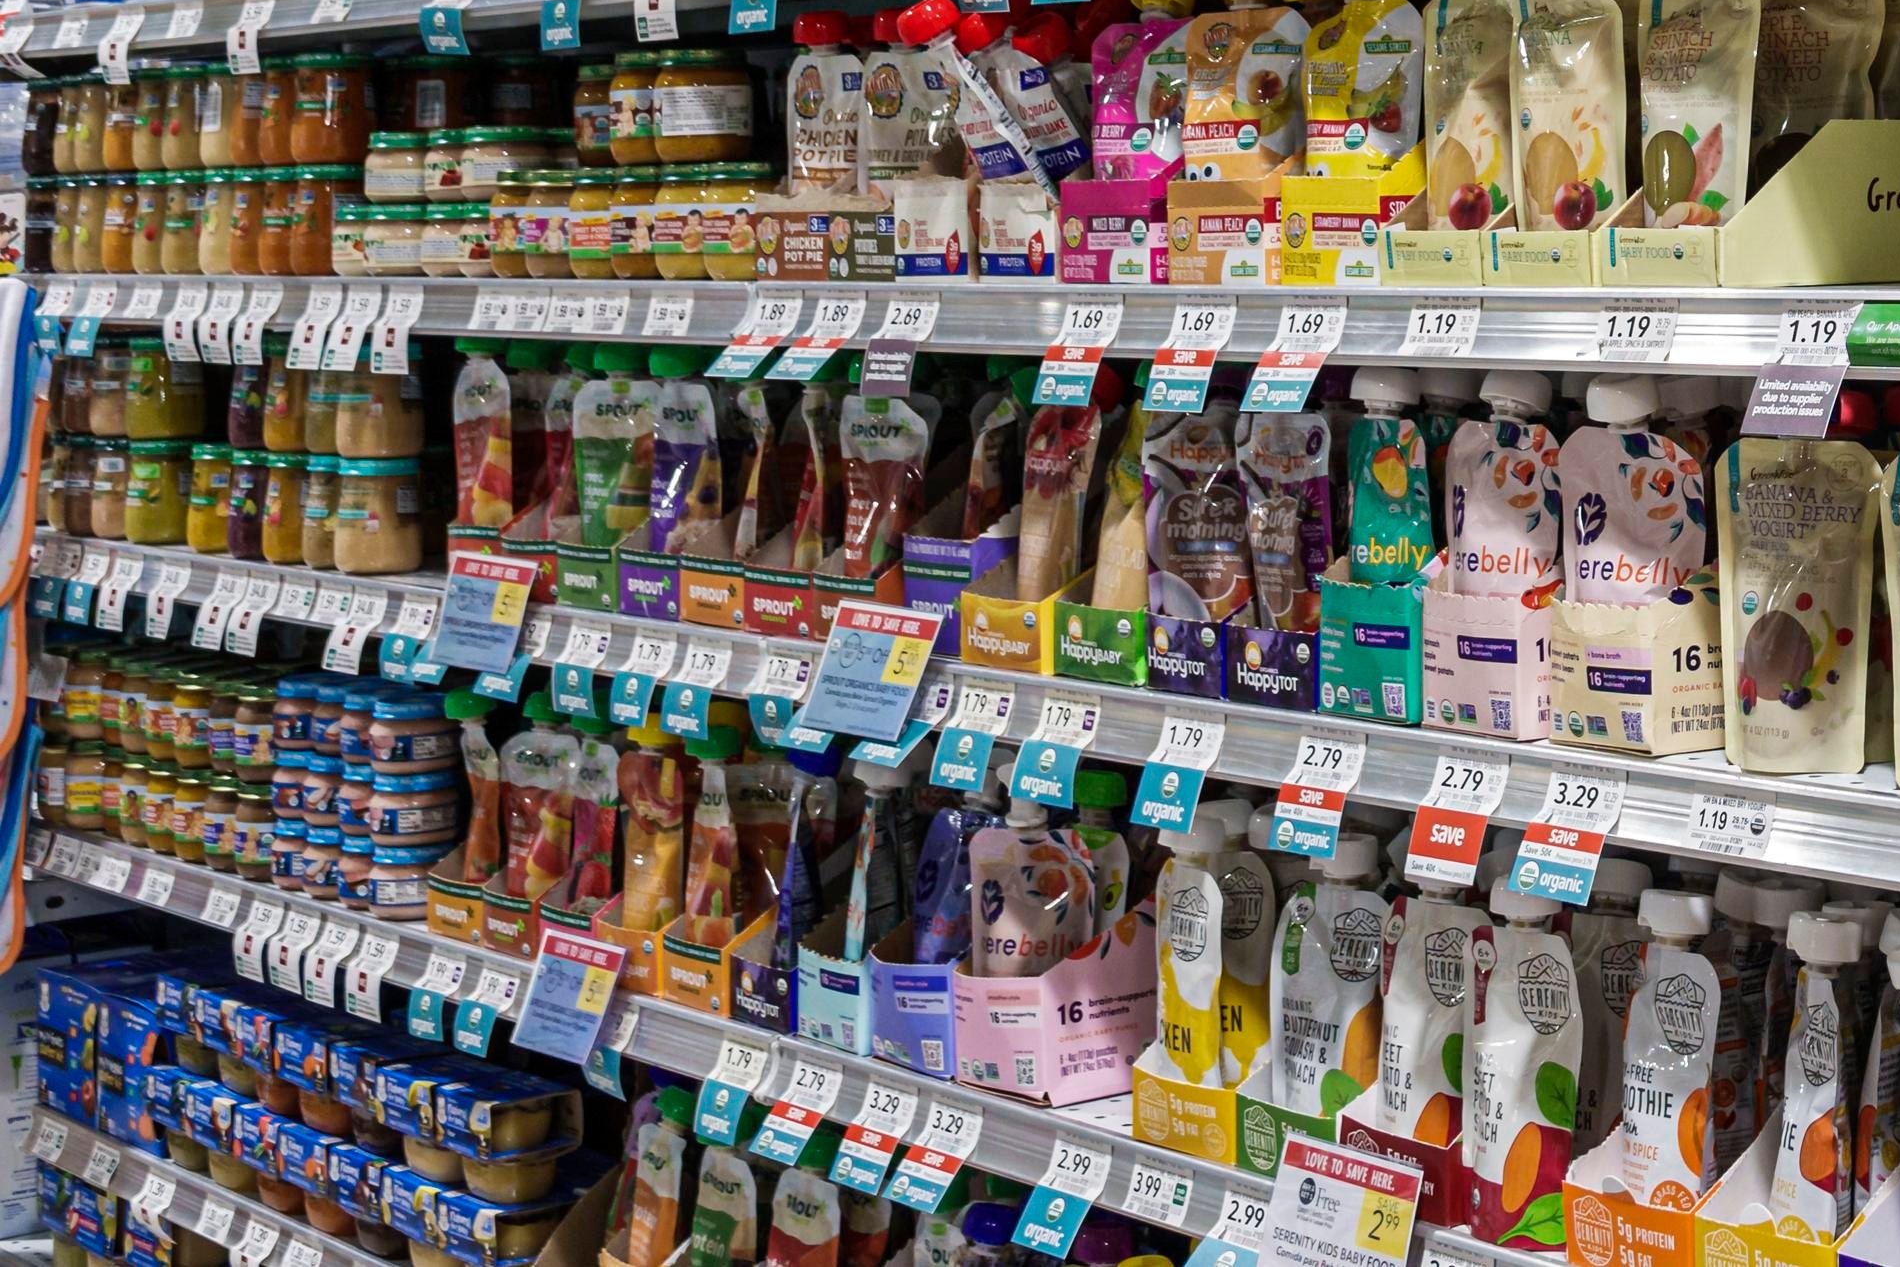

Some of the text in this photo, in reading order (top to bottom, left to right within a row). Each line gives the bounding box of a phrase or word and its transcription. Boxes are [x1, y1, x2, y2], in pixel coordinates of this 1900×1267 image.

[783, 238, 824, 251] CHICKEN
[783, 250, 824, 263] POT PIE
[890, 306, 922, 326] 2.69
[1071, 309, 1103, 329] 1.69
[1287, 314, 1323, 333] 1.69
[1417, 314, 1457, 334] 1.19
[1788, 320, 1837, 343] 1.19
[1279, 352, 1305, 366] save
[1759, 379, 1834, 395] Limited availability
[1752, 403, 1824, 417] production issues
[1762, 392, 1823, 408] due to supplier
[689, 585, 730, 603] SPROUT
[1672, 644, 1701, 673] 16
[1237, 661, 1298, 694] HappyTOT
[1168, 725, 1203, 748] 1.79
[1441, 767, 1484, 790] 2.79
[1554, 782, 1599, 808] 3.29
[1142, 800, 1184, 822] organic
[1698, 807, 1728, 832] 1.19
[1430, 823, 1465, 847] save
[1539, 876, 1585, 894] organic
[1521, 984, 1569, 1011] SERENITY
[1056, 1000, 1084, 1025] 16
[1538, 1010, 1558, 1019] KIDS
[933, 1111, 964, 1135] 3.29
[1057, 1148, 1091, 1175] 2.99
[1304, 1151, 1395, 1191] LOVE TO SAVE HERE.
[1227, 1201, 1265, 1227] 2.99
[1023, 1222, 1064, 1246] organic
[1617, 1216, 1675, 1251] 5g PROTEIN
